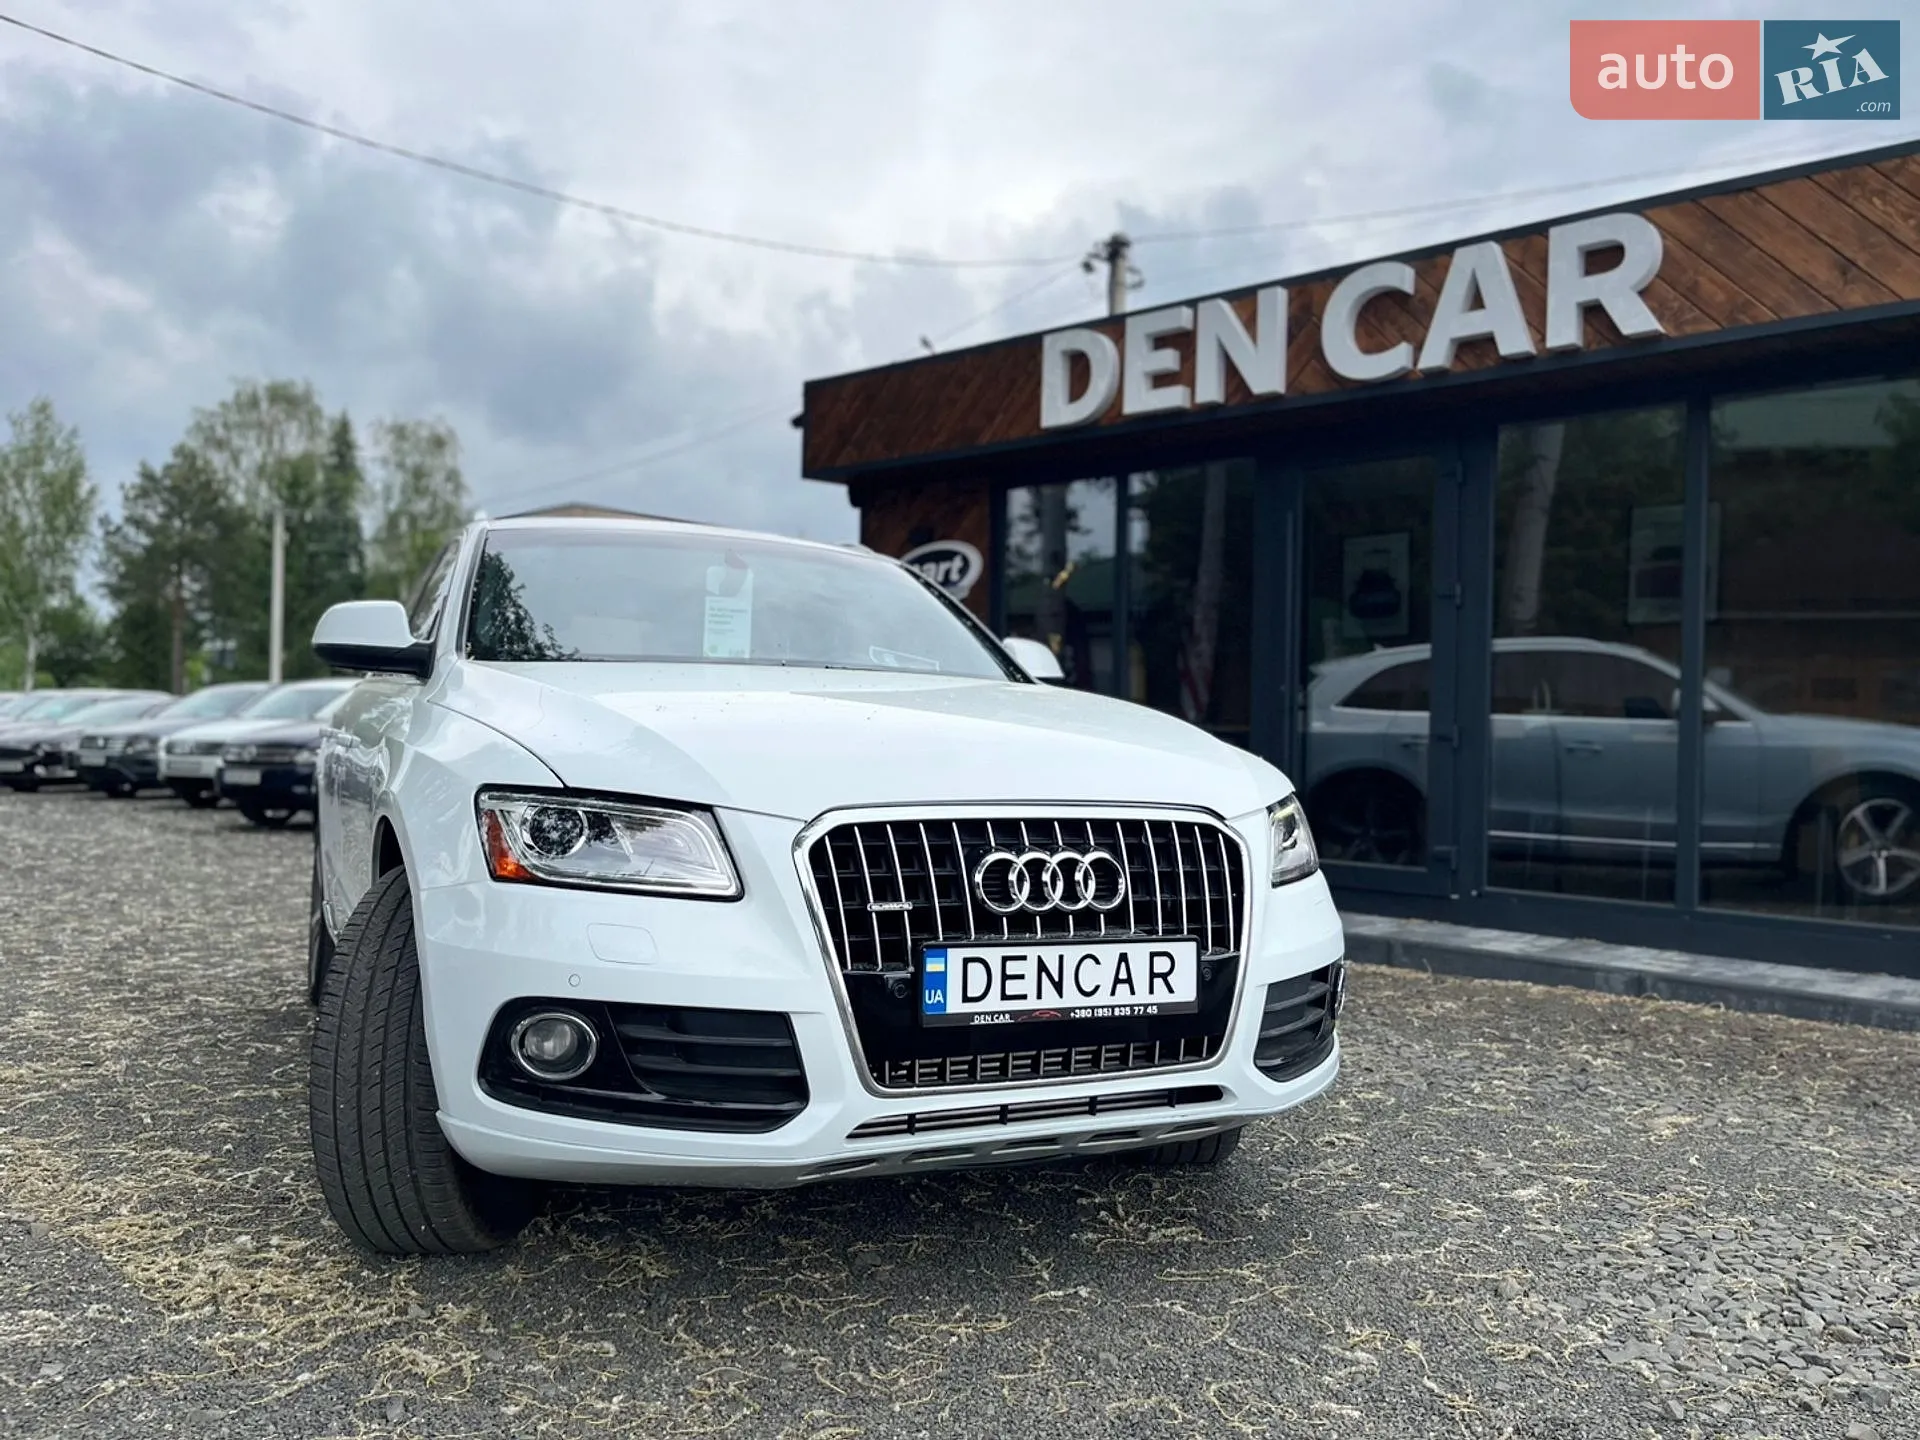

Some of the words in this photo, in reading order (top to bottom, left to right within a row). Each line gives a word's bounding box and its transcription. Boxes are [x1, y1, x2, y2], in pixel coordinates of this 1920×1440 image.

[1040, 286, 1289, 429] DEN
[1320, 213, 1664, 381] CAR
[961, 951, 1176, 1003] DENCAR
[925, 990, 944, 1004] UA
[1114, 1006, 1131, 1016] 835
[1133, 1006, 1145, 1015] 77
[1147, 1005, 1158, 1014] 45
[974, 1015, 991, 1024] DEN
[993, 1013, 1011, 1023] CAR
